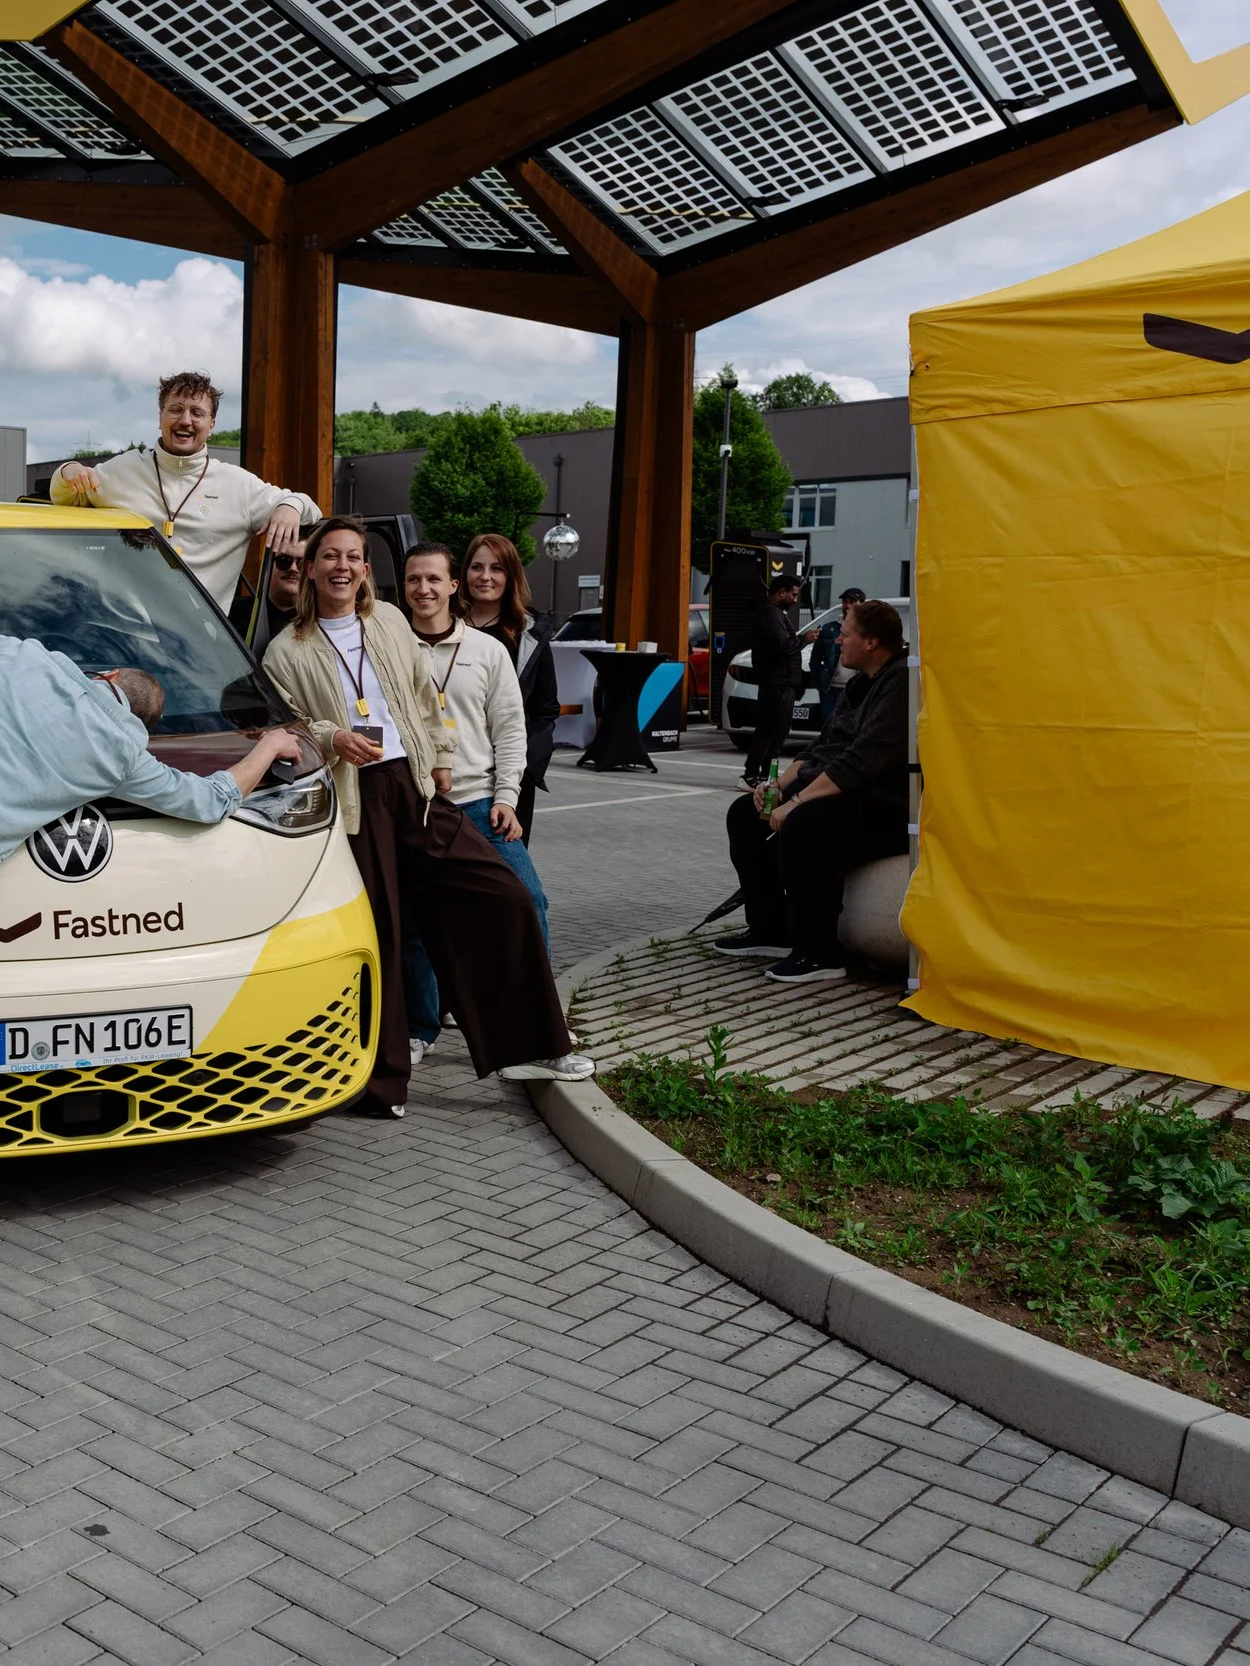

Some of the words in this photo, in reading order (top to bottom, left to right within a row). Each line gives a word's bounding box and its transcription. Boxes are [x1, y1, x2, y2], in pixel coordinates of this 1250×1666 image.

[732, 546, 746, 554] 400
[53, 902, 184, 939] Fastned
[9, 1027, 29, 1059] D
[52, 1022, 95, 1056] FN
[103, 1014, 186, 1051] 106E
